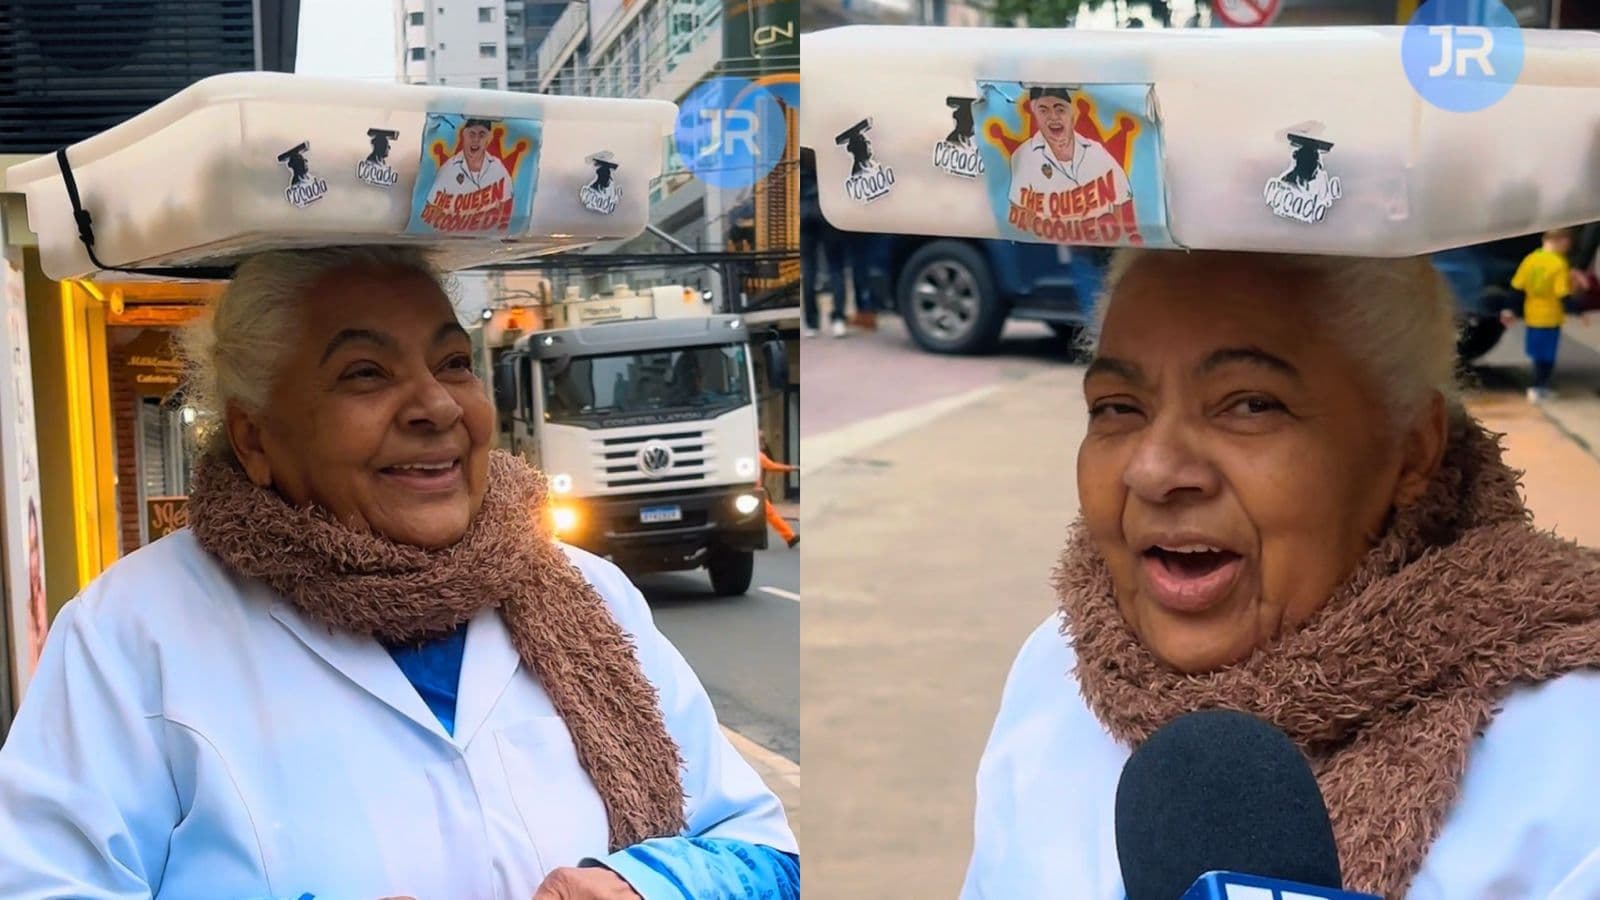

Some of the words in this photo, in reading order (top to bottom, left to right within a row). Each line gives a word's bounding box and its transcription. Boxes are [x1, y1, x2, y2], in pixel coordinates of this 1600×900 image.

[358, 160, 398, 184] Cocada
[846, 165, 895, 200] Cocada
[286, 177, 327, 205] Cocada
[433, 190, 453, 210] THE
[454, 177, 505, 212] QUEEN
[1020, 187, 1045, 213] THE
[1049, 169, 1117, 219] QUEEN
